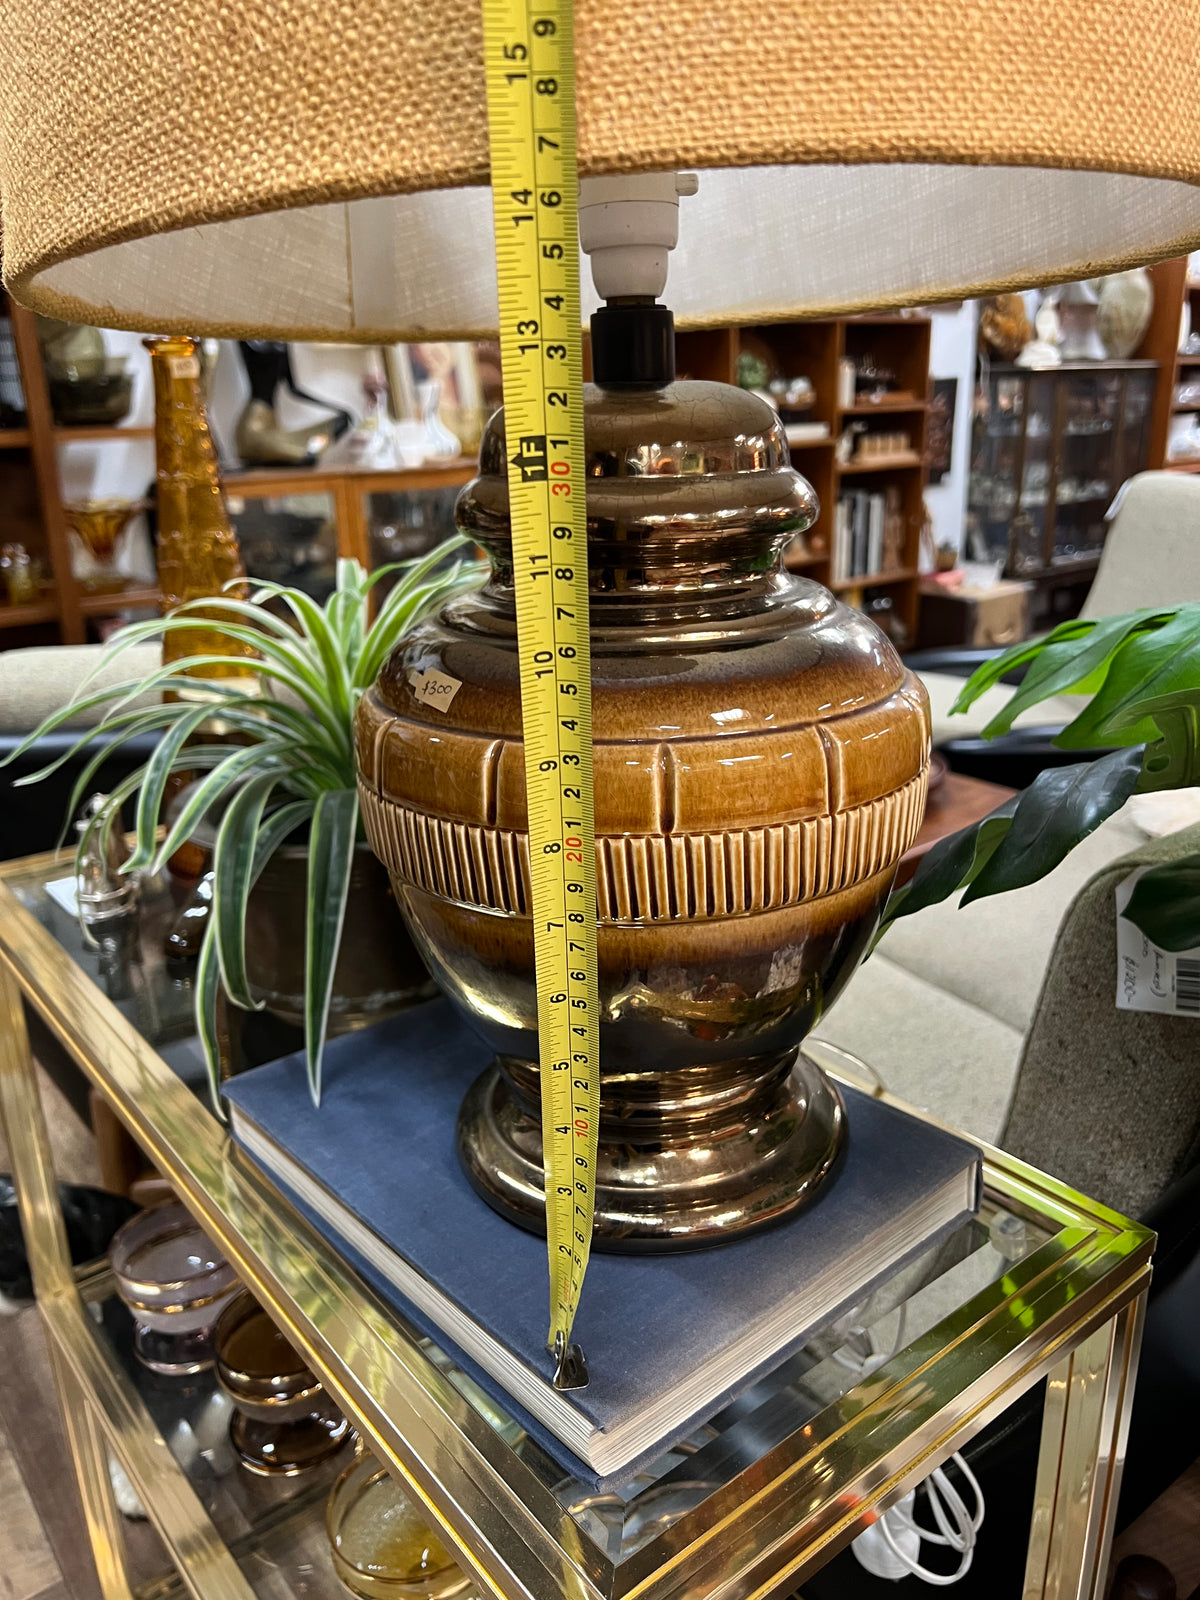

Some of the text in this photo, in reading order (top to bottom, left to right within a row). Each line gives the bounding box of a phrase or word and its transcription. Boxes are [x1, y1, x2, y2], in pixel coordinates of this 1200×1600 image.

[533, 19, 556, 37] 9
[503, 43, 527, 87] 15
[536, 78, 558, 96] 8
[538, 136, 559, 154] 7
[540, 191, 562, 208] 6
[511, 188, 534, 227] 14
[543, 244, 563, 260] 5
[544, 295, 564, 311] 4
[517, 320, 539, 356] 13
[546, 344, 567, 360] 3
[548, 392, 568, 407] 2
[549, 440, 569, 450] 1
[522, 441, 545, 477] 1F
[550, 461, 571, 497] 30
[553, 526, 572, 540] 9
[529, 554, 549, 581] 11
[555, 568, 574, 581] 8
[556, 607, 575, 620] 7
[558, 646, 577, 659] 6
[533, 651, 554, 679] 10
[421, 680, 453, 696] $300
[560, 683, 578, 696] 5
[561, 719, 579, 731] 4
[539, 760, 558, 772] 9
[562, 754, 580, 766] 3
[563, 787, 581, 800] 2
[564, 820, 582, 829] 1
[543, 842, 561, 854] 8
[565, 837, 583, 864] 20
[566, 883, 584, 894] 9
[568, 913, 585, 924] 8
[546, 922, 564, 932] 7
[569, 942, 586, 952] 7
[570, 971, 587, 981] 6
[549, 993, 567, 1004] 6
[571, 999, 588, 1010] 5
[572, 1027, 588, 1037] 4
[572, 1053, 589, 1064] 3
[552, 1061, 569, 1071] 5
[573, 1079, 589, 1091] 2
[574, 1105, 589, 1113] 1
[555, 1125, 571, 1135] 4
[574, 1119, 589, 1138] 10
[575, 1157, 588, 1169] 9
[557, 1186, 573, 1196] 3
[575, 1181, 588, 1194] 8
[575, 1205, 587, 1219] 7
[574, 1230, 585, 1244] 6
[558, 1244, 572, 1257] 2
[574, 1254, 582, 1269] 5
